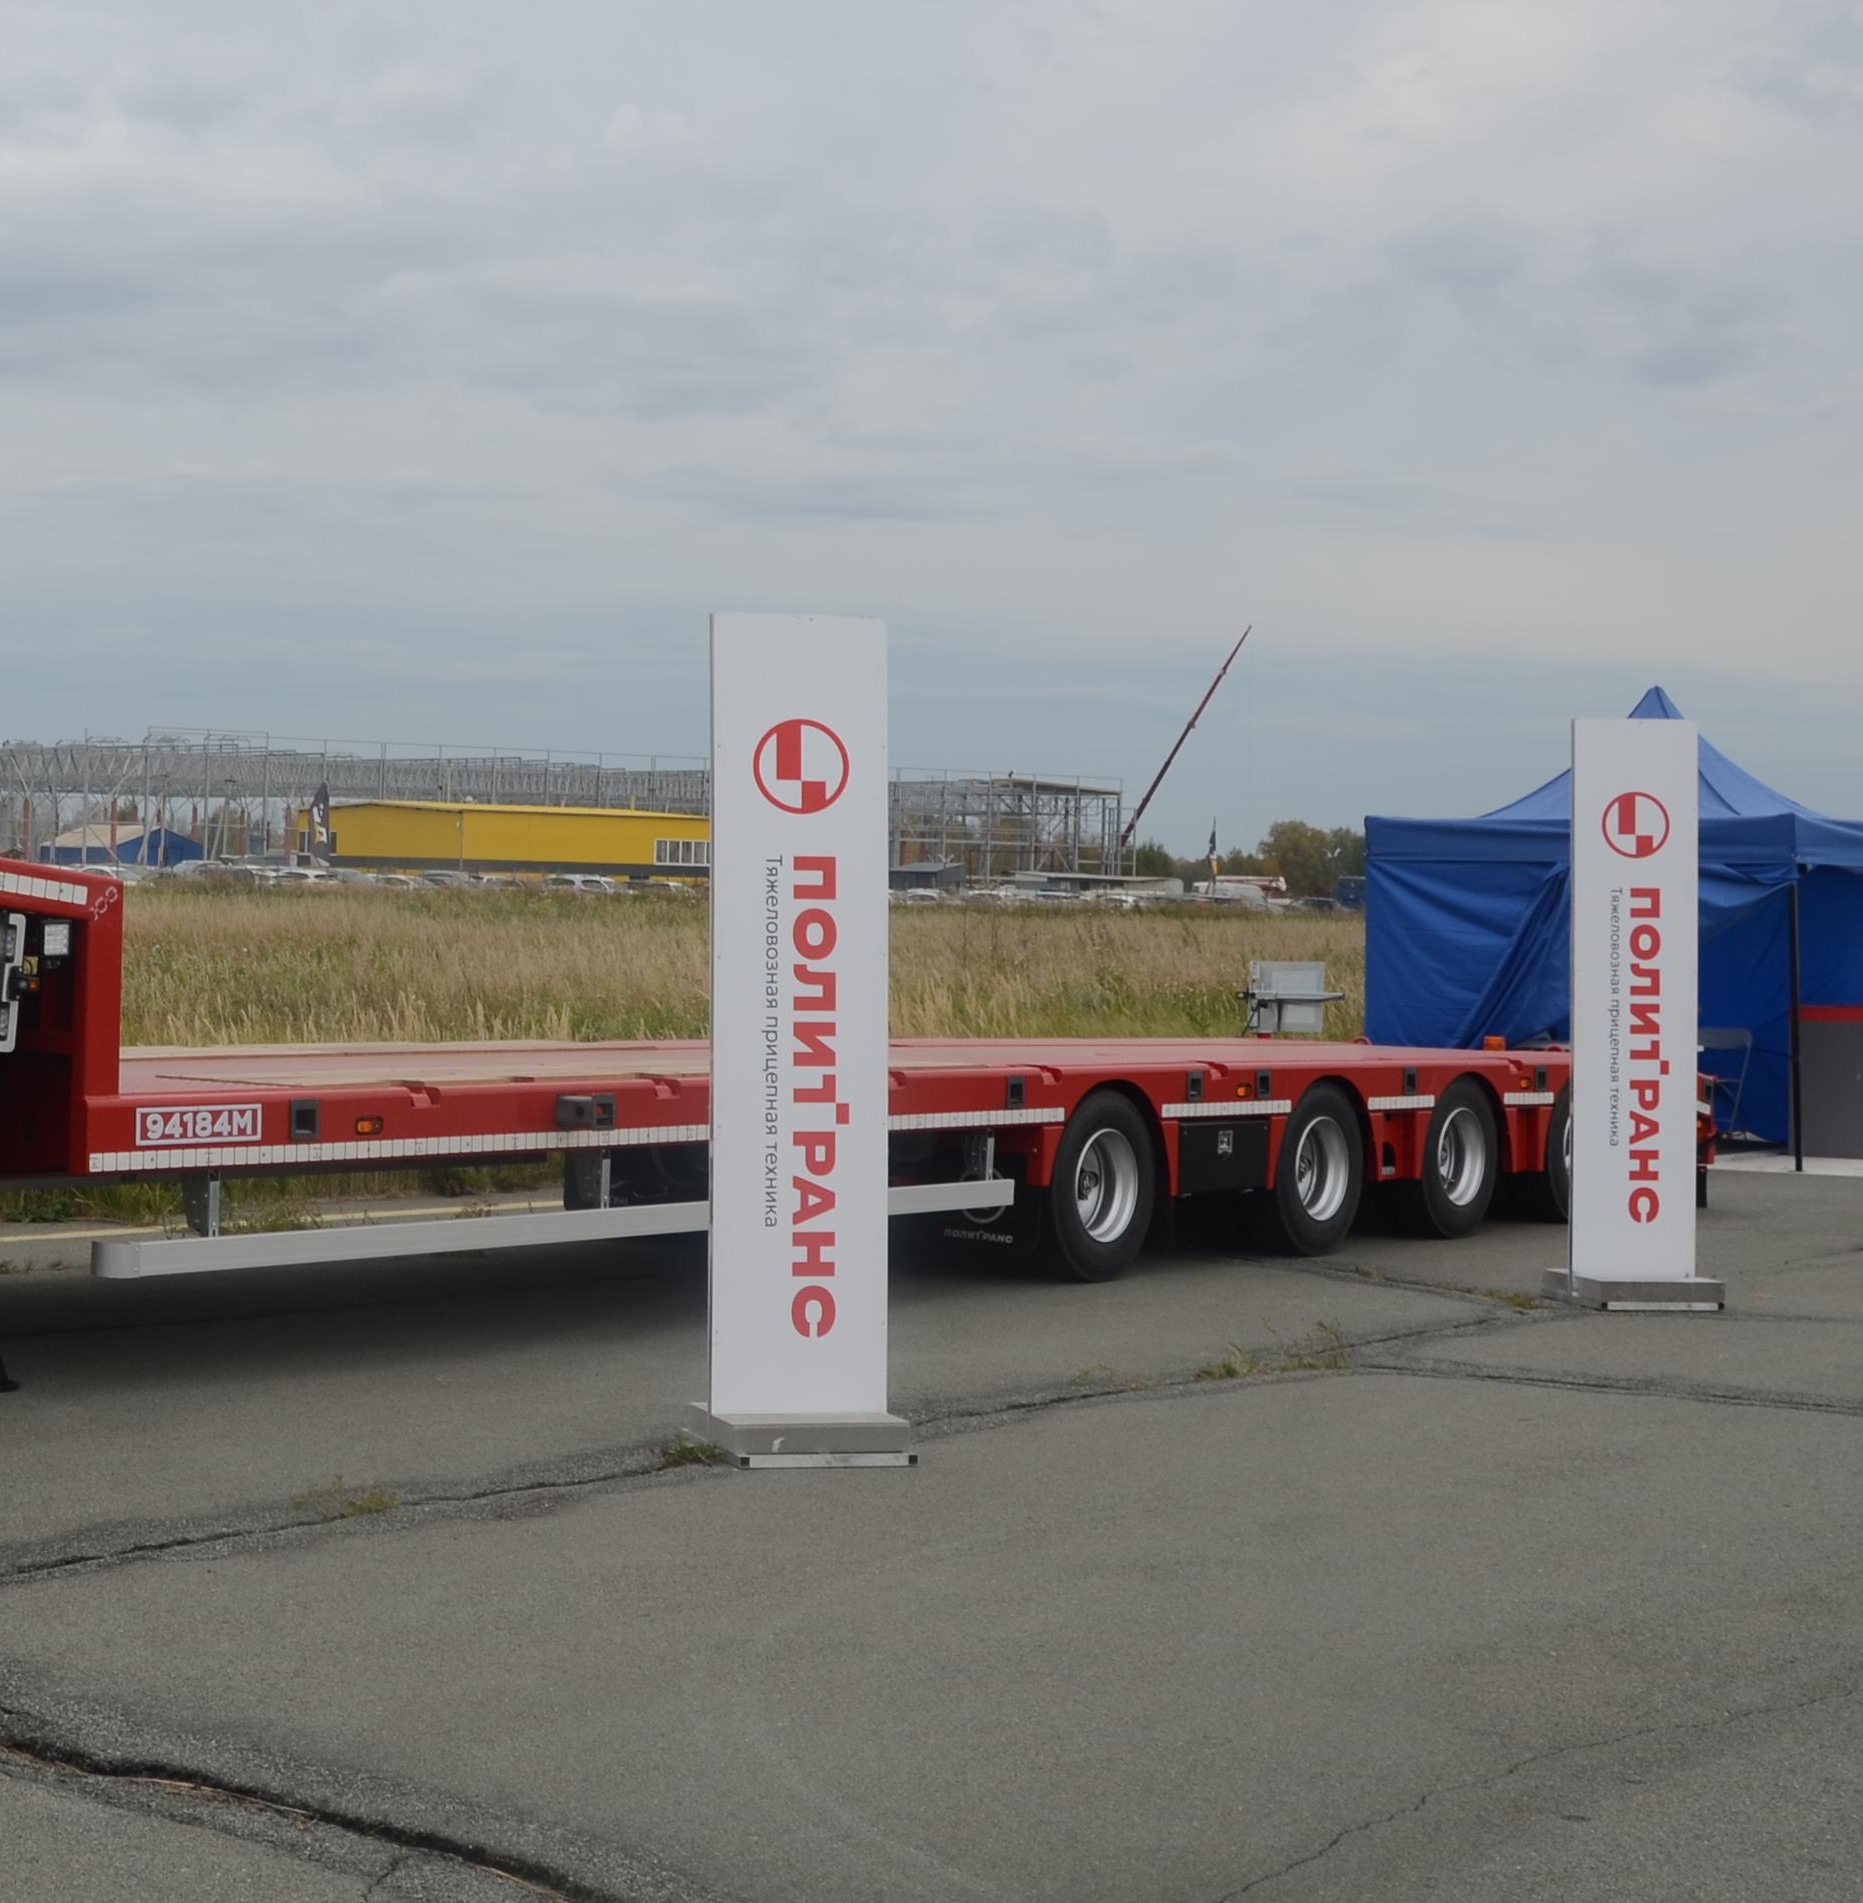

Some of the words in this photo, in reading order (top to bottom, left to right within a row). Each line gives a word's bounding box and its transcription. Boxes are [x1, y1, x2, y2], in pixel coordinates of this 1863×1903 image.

[765, 855, 784, 1009] Тяжеловозная
[1609, 887, 1623, 995] Тяжеловозная
[760, 1016, 779, 1135] прицепная
[1607, 999, 1620, 1083] прицепная
[1628, 887, 1670, 1223] ПОЛИТРАНС
[791, 855, 850, 1338] ПОЛИТРАНС
[1609, 1087, 1619, 1147] техника
[764, 1141, 778, 1228] техника
[943, 1228, 1014, 1243] ПОЛИТРАНС
